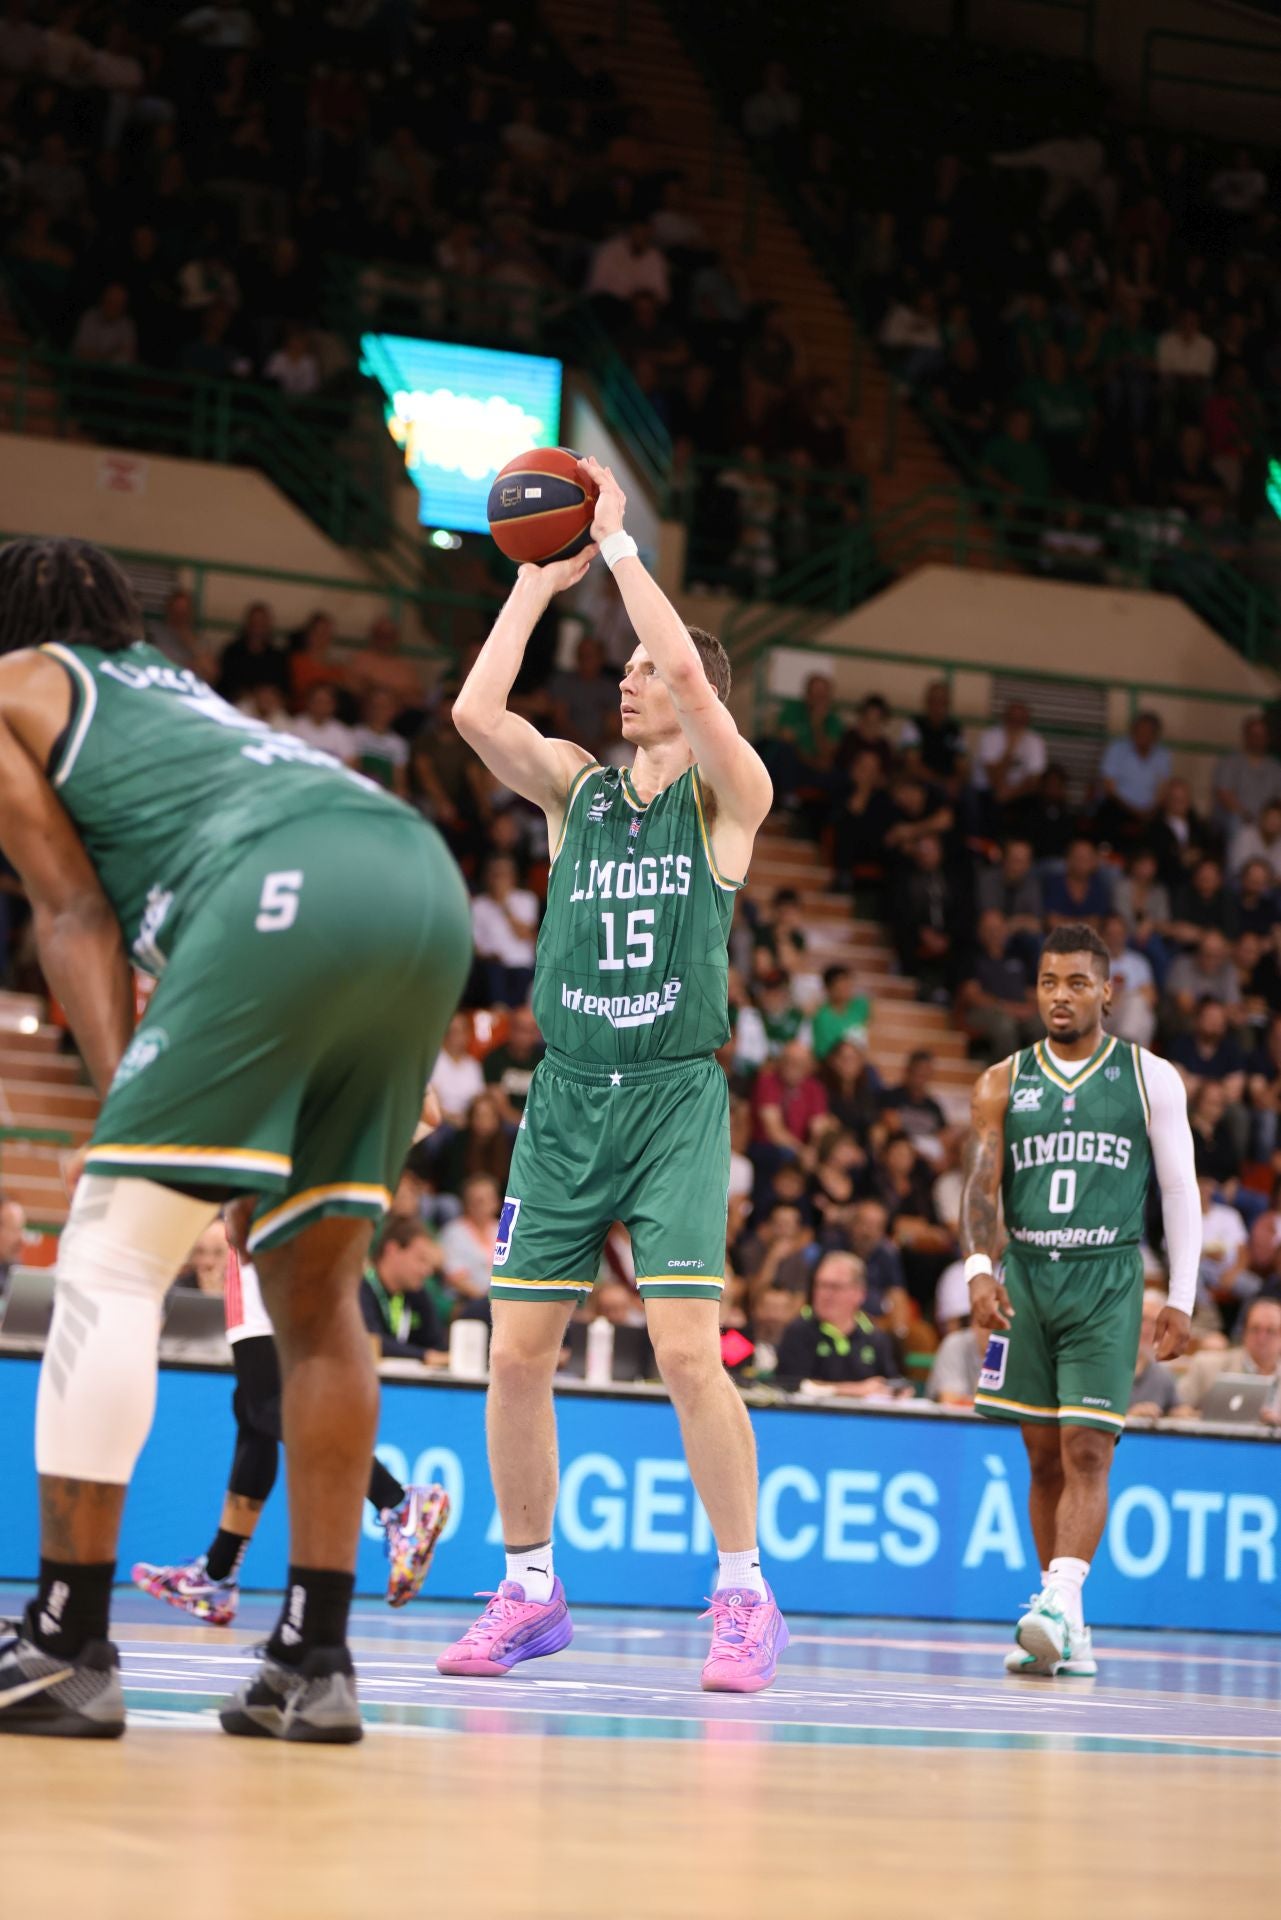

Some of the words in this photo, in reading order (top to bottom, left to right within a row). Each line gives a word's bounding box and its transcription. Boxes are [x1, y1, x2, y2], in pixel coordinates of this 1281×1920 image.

[255, 870, 303, 932] 5
[598, 909, 655, 970] 15
[1011, 1131, 1132, 1171] LIMOGES
[1049, 1169, 1077, 1213] 0
[962, 1454, 1026, 1570] À
[1108, 1485, 1279, 1582] OTR
